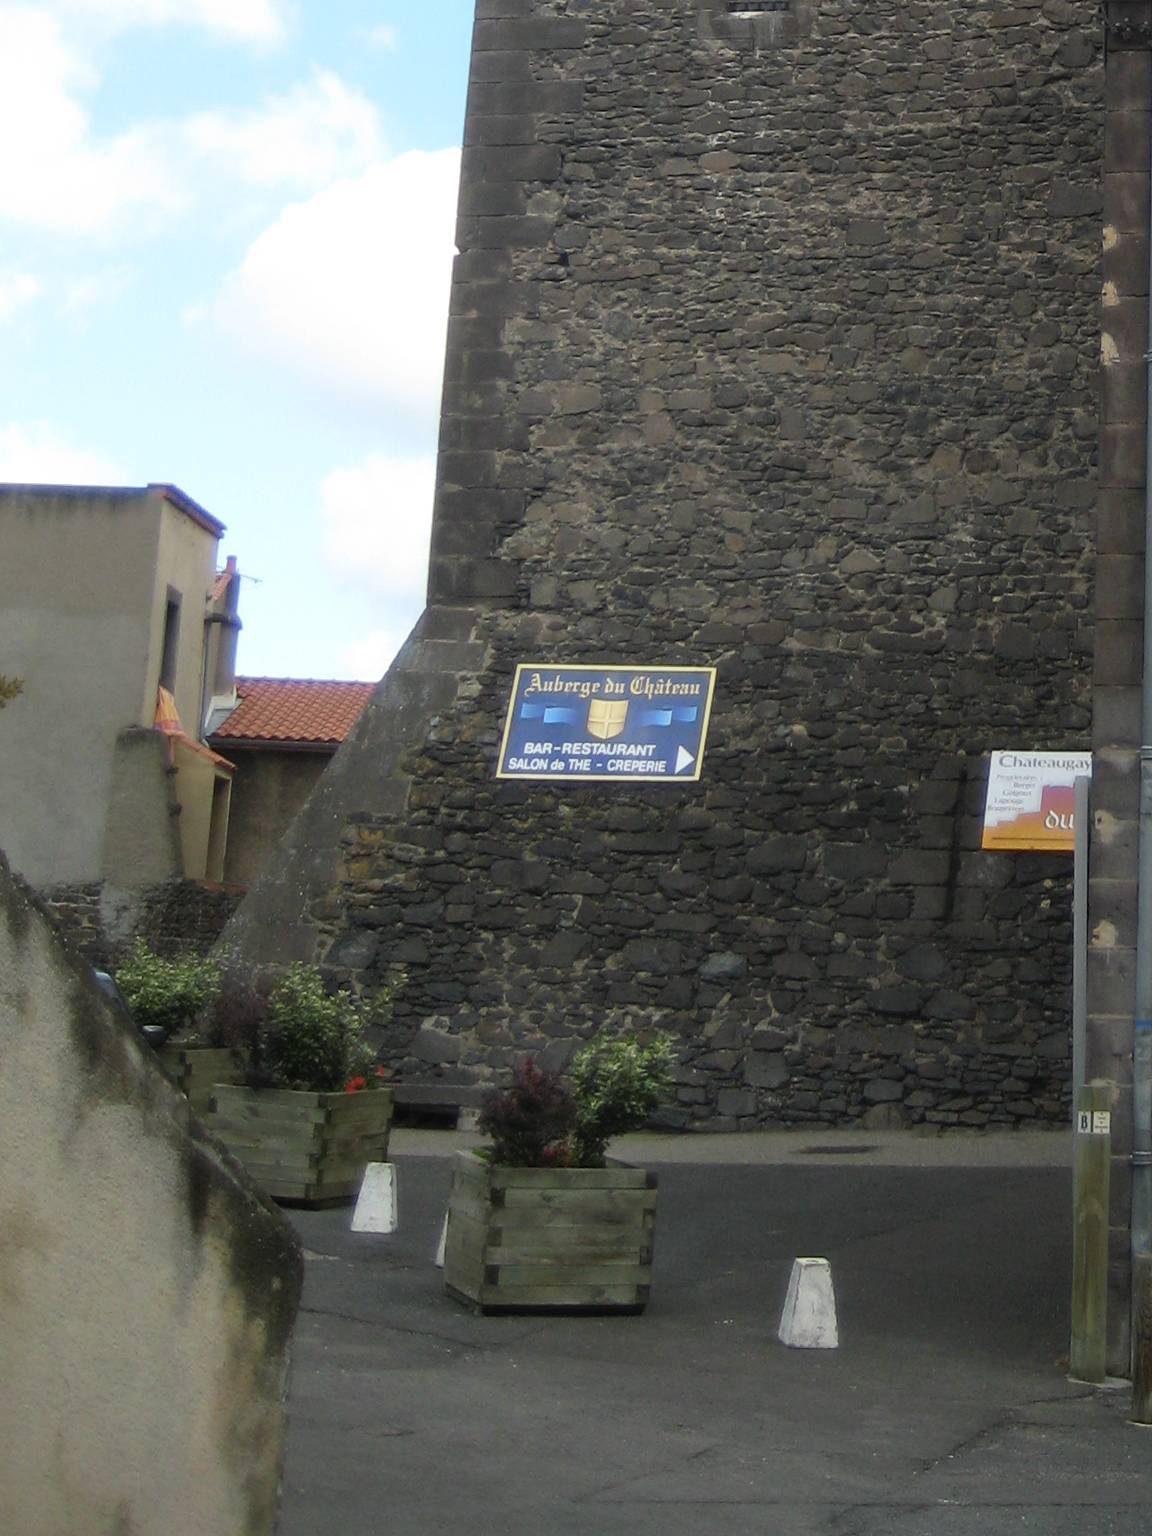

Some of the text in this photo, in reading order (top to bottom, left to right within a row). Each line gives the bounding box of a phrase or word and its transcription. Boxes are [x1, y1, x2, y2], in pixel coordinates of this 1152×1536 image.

[525, 672, 700, 699] Auberge du Château
[524, 742, 656, 757] BAR-RESTAURANT
[508, 757, 548, 771] SALON
[551, 759, 565, 771] de
[569, 758, 591, 771] THE
[607, 759, 666, 773] CREPERIE
[1045, 810, 1074, 829] du
